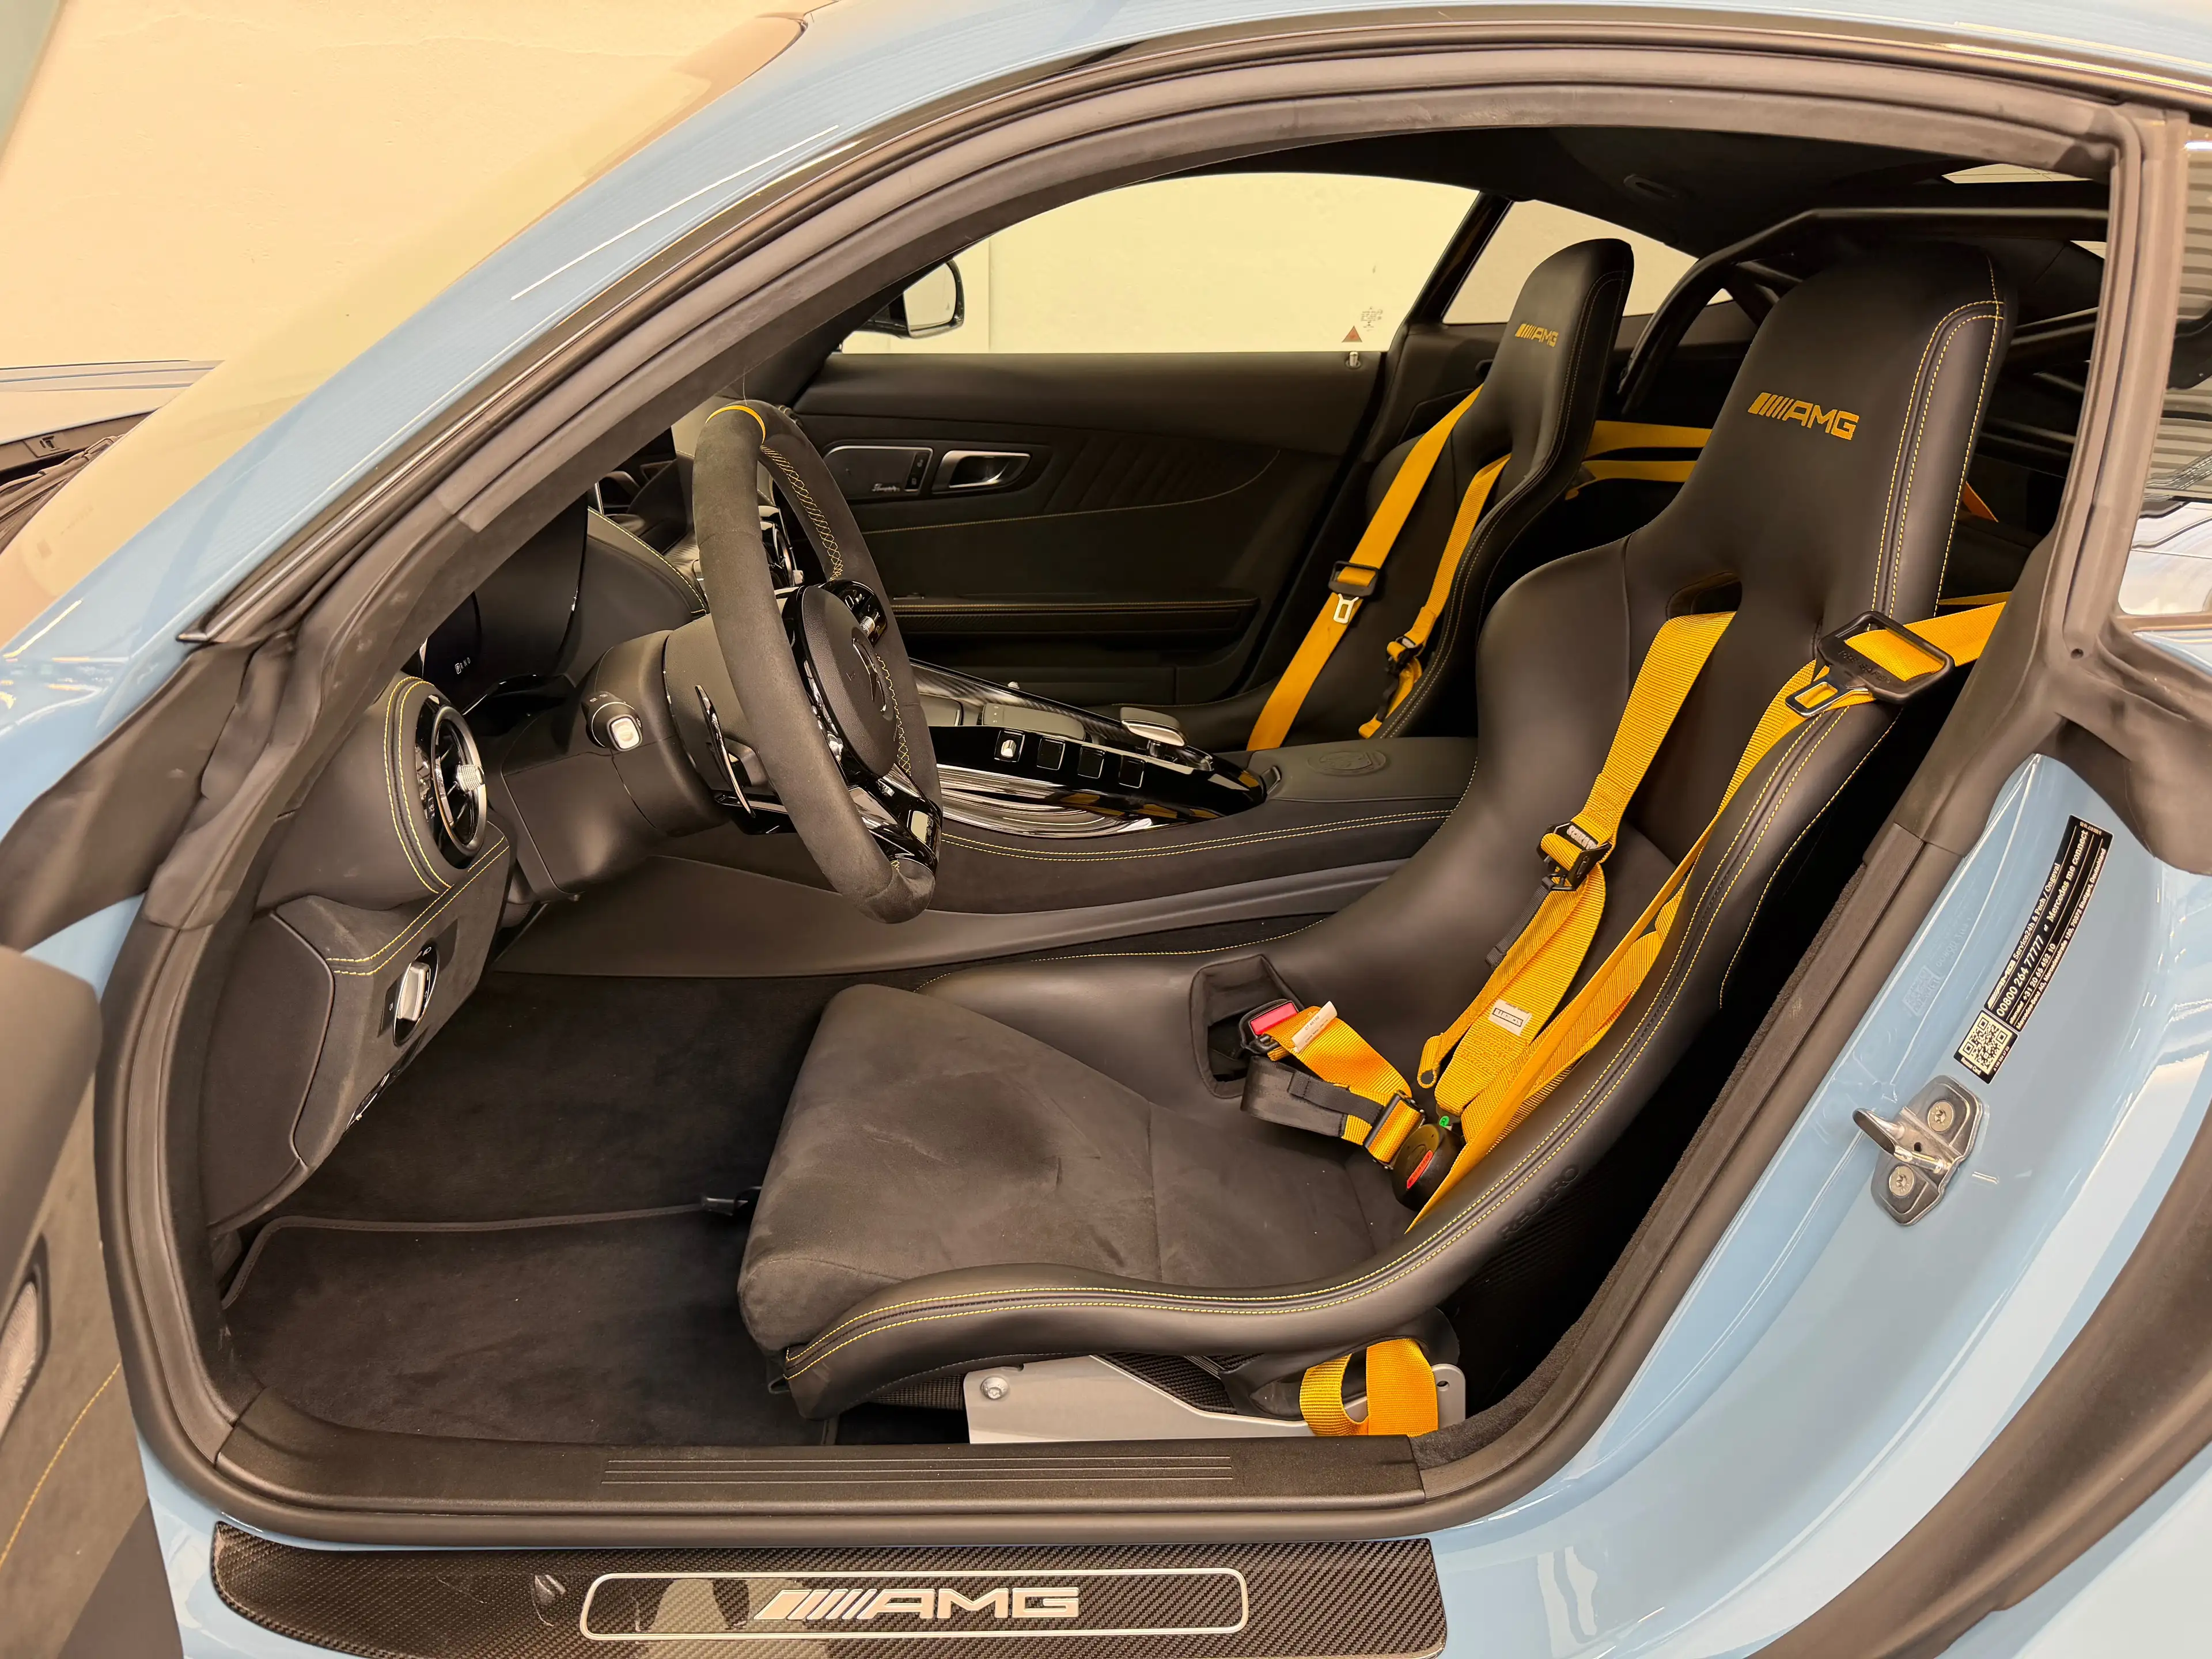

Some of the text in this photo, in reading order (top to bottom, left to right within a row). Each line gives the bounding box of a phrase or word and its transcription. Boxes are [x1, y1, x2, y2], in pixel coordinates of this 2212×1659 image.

[1531, 327, 1559, 347] AMG
[1782, 400, 1859, 440] AMG
[1995, 959, 2016, 994] AMG
[2013, 922, 2035, 960] Service24h
[2034, 898, 2046, 915] Pech
[2045, 862, 2061, 892] Ongeval
[1997, 986, 2018, 1017] 00800
[2014, 967, 2028, 987] 264
[2024, 934, 2043, 967] 77777
[2046, 881, 2069, 922] Mercedes
[2066, 866, 2075, 880] me
[2072, 830, 2088, 865] connect
[2065, 928, 2074, 940] 120,
[2030, 977, 2038, 987] 20
[2036, 967, 2043, 978] 65
[2041, 953, 2051, 967] 452
[2048, 943, 2055, 952] 10
[857, 1588, 1079, 1620] AMG
